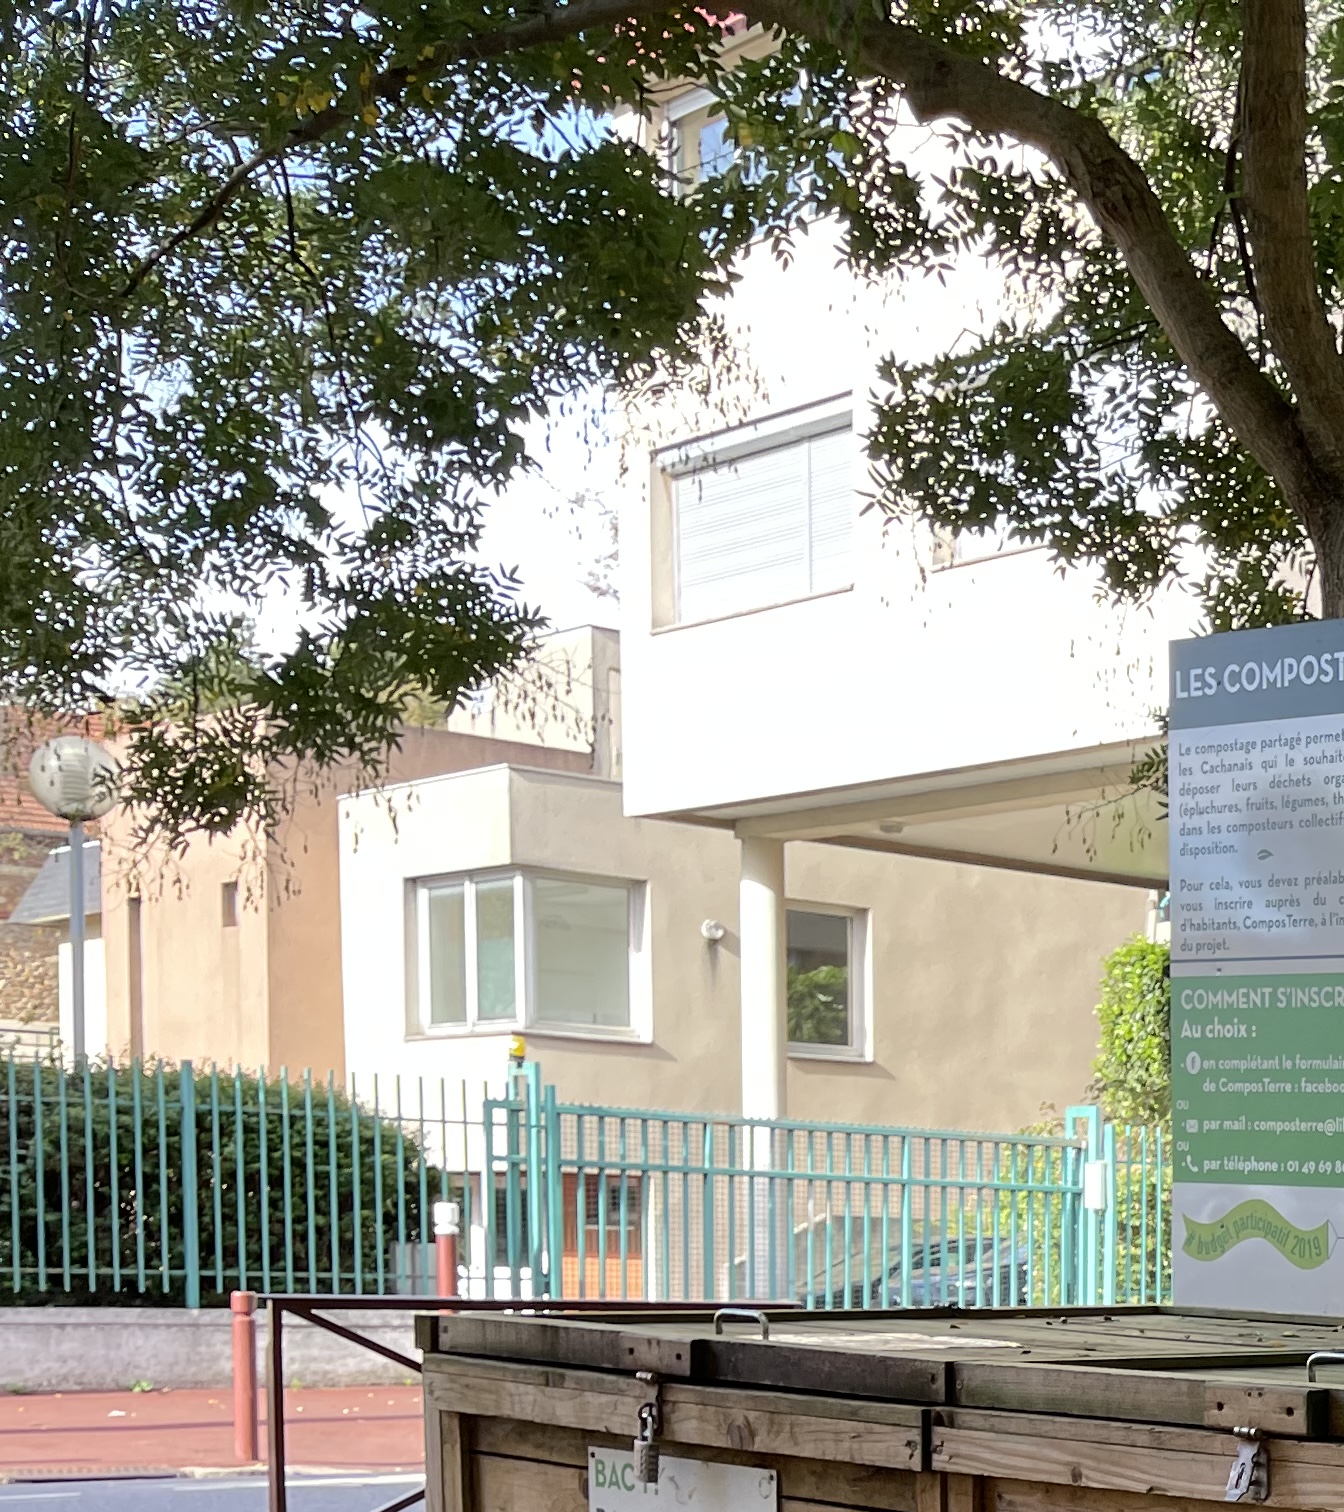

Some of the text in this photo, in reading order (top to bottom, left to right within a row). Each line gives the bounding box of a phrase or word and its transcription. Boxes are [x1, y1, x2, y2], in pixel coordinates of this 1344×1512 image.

[1176, 666, 1217, 699] LES
[1177, 741, 1192, 757] Le
[1193, 737, 1257, 757] compostage
[1259, 733, 1302, 753] partagé
[1177, 780, 1221, 800] déposer
[1230, 777, 1258, 793] leurs
[1267, 772, 1312, 790] déchets
[1178, 839, 1239, 860] disposition.
[1178, 901, 1204, 912] vous
[1213, 895, 1253, 911] inscrire
[1263, 892, 1301, 912] auprès
[1311, 891, 1327, 907] du
[1179, 986, 1273, 1010] COMMENT
[1201, 1076, 1217, 1092] de
[1217, 1076, 1292, 1097] ComposTerre
[1202, 1158, 1222, 1174] par
[1222, 1155, 1279, 1175] téléphone
[1285, 1159, 1299, 1173] 01
[1300, 1159, 1316, 1174] 49
[1317, 1158, 1333, 1175] 69
[1197, 1224, 1234, 1255] budget
[1232, 1208, 1292, 1249] participatif
[1291, 1234, 1323, 1260] 2019
[595, 1458, 636, 1492] BAC
